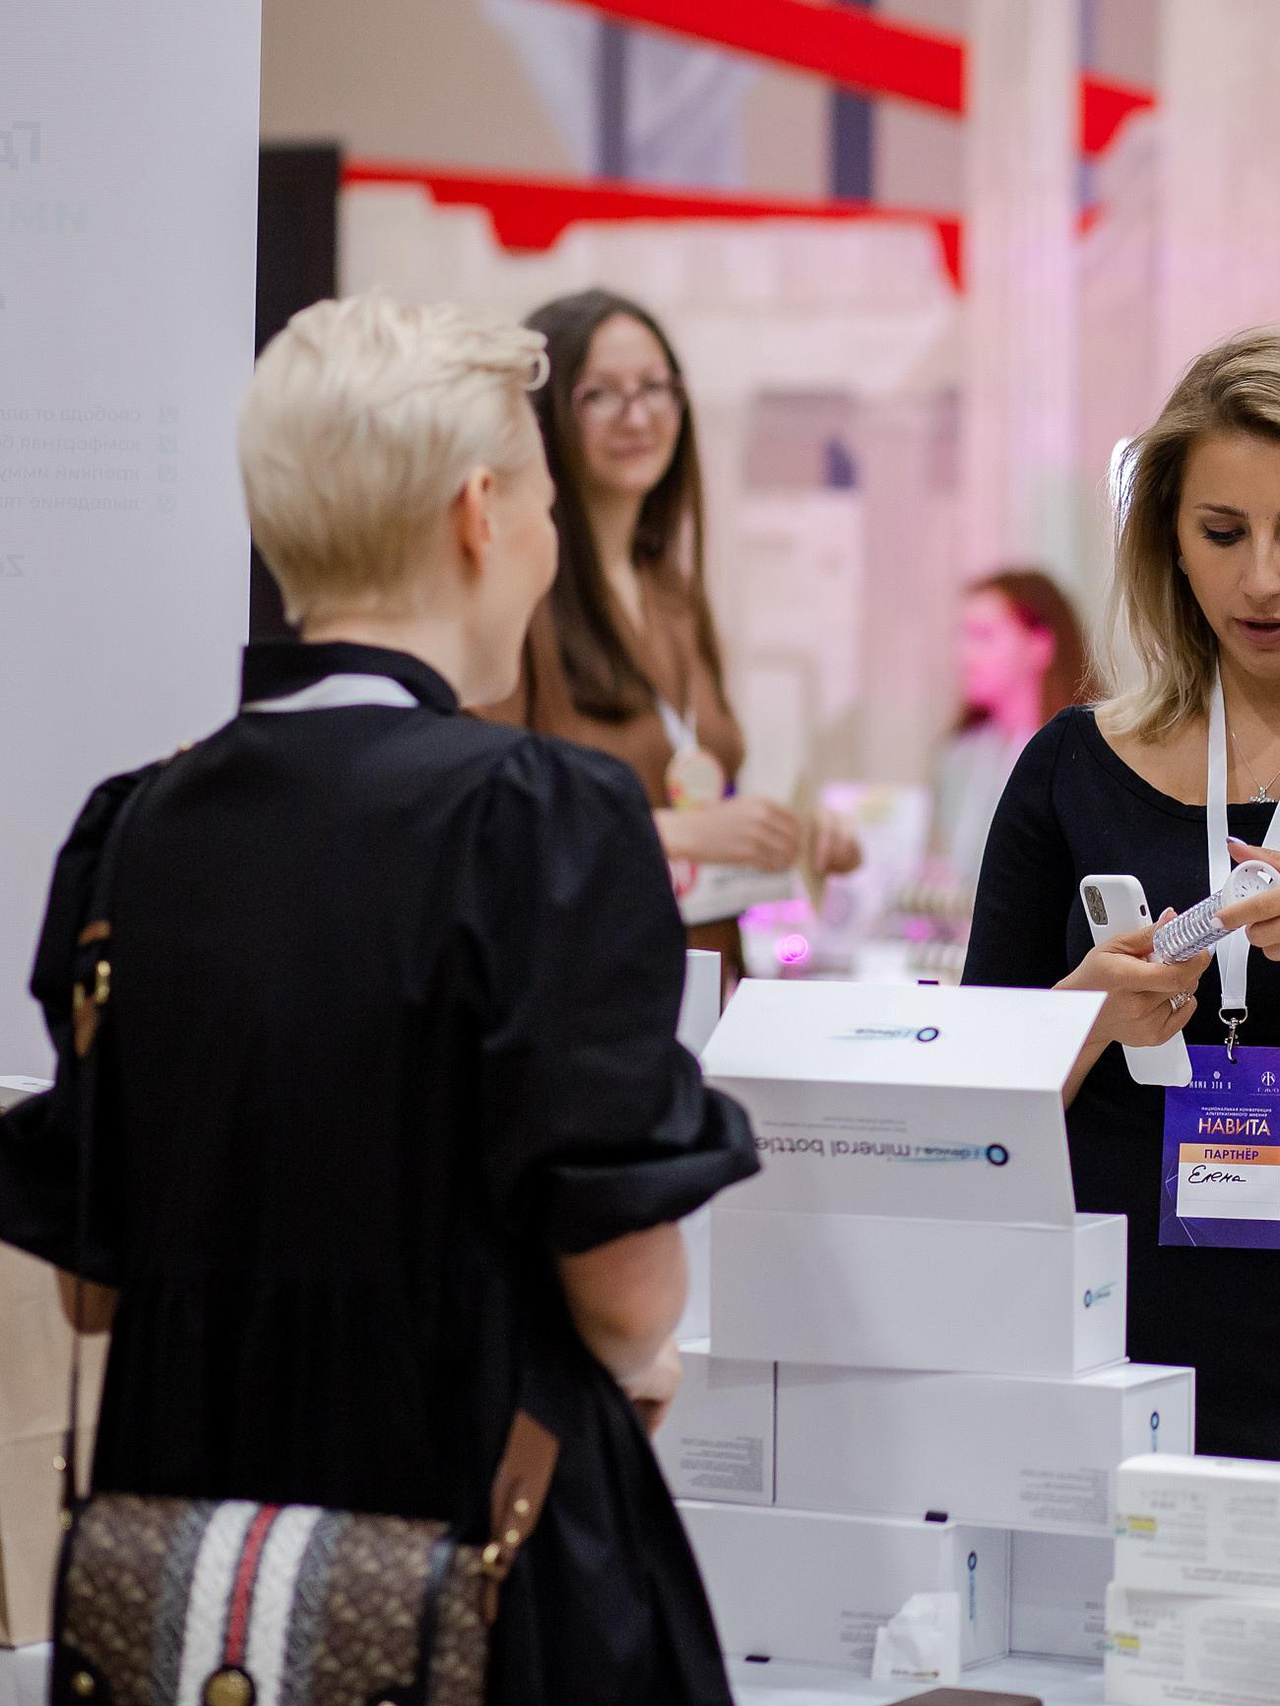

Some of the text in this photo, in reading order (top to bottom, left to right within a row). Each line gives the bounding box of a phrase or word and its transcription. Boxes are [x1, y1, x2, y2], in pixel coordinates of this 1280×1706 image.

[1198, 1117, 1271, 1136] НАВИТА
[830, 1139, 910, 1158] mineral
[1204, 1147, 1259, 1161] ПАРТНЁР
[1188, 1164, 1247, 1184] Елена
